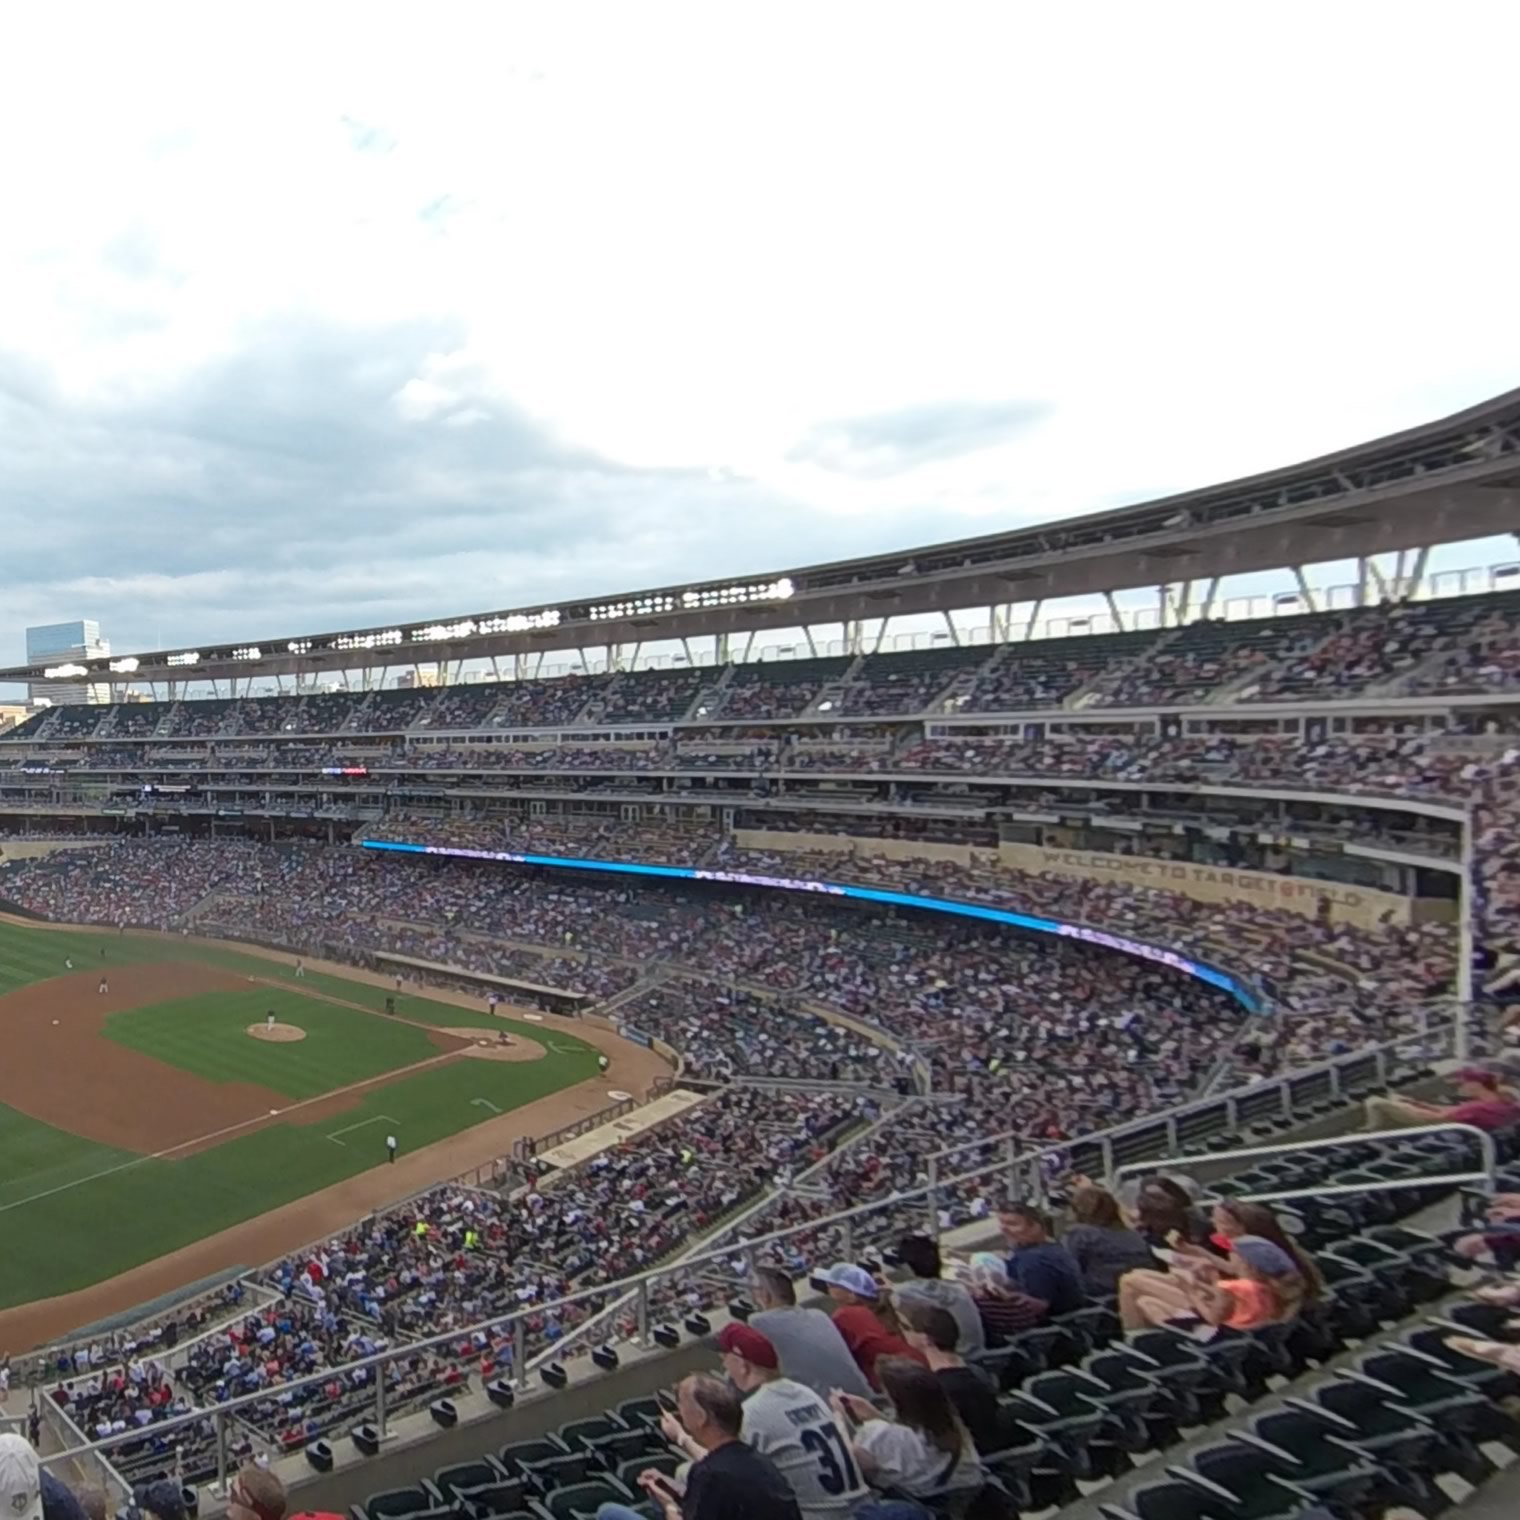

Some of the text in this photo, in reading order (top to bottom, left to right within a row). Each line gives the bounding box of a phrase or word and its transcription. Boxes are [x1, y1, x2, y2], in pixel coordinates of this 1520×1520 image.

[1043, 851, 1157, 875] WELCOME
[1157, 862, 1186, 879] TO
[1192, 869, 1276, 893] TARGET
[800, 1421, 860, 1496] 37
